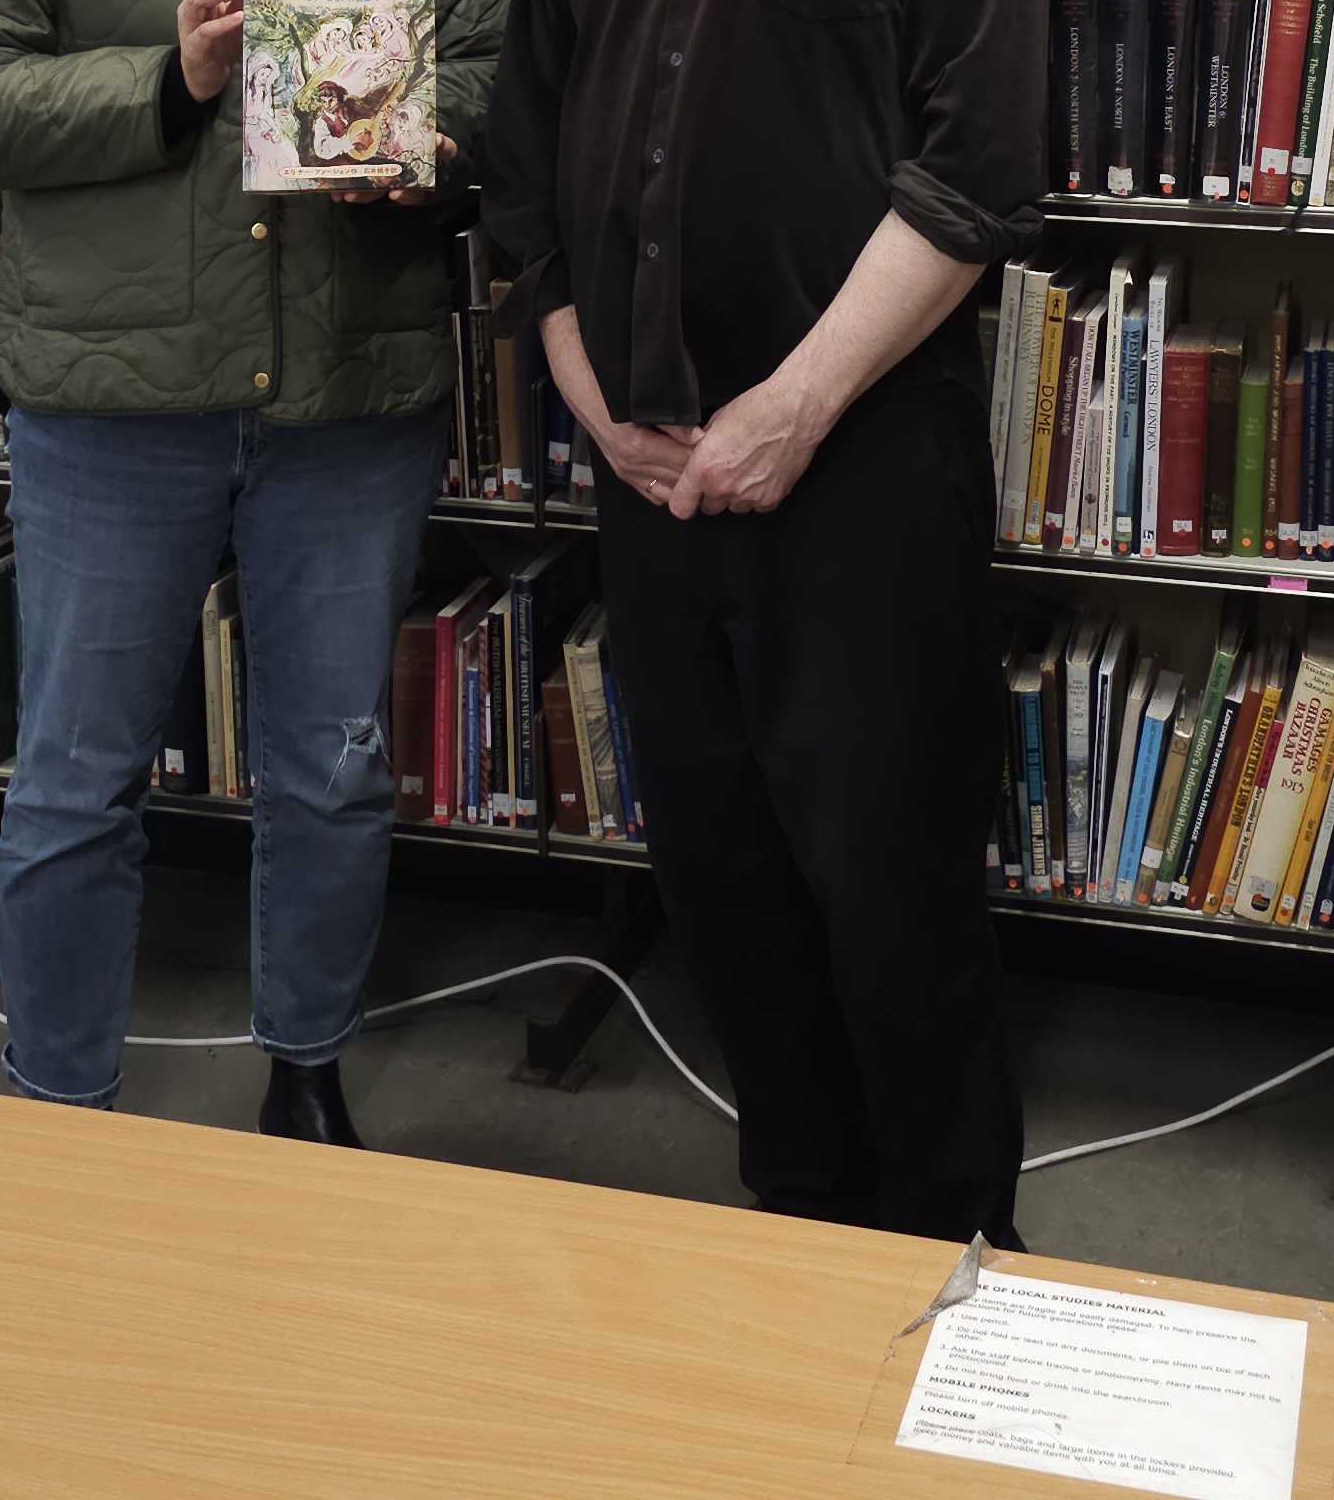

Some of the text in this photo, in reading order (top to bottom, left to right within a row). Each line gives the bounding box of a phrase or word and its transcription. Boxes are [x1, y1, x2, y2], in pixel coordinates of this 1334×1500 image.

[1208, 55, 1219, 128] WESTMINSTER
[1220, 66, 1229, 108] LONDON
[1037, 385, 1054, 435] DOME
[1147, 340, 1159, 451] LAWYERS' LONDON
[1282, 701, 1307, 759] BAZAAR
[1292, 697, 1320, 776] CHRISTMAS
[1306, 708, 1333, 773] GAMAGES
[993, 1285, 1166, 1317] OF LOCAL STUDIES MATERIAL
[925, 1390, 955, 1400] Please
[958, 1395, 977, 1405] turn
[997, 1403, 1029, 1413] mobile
[1032, 1408, 1070, 1420] phones.
[929, 1376, 1030, 1398] MOBILE PHONES
[920, 1405, 976, 1420] LOCKERS
